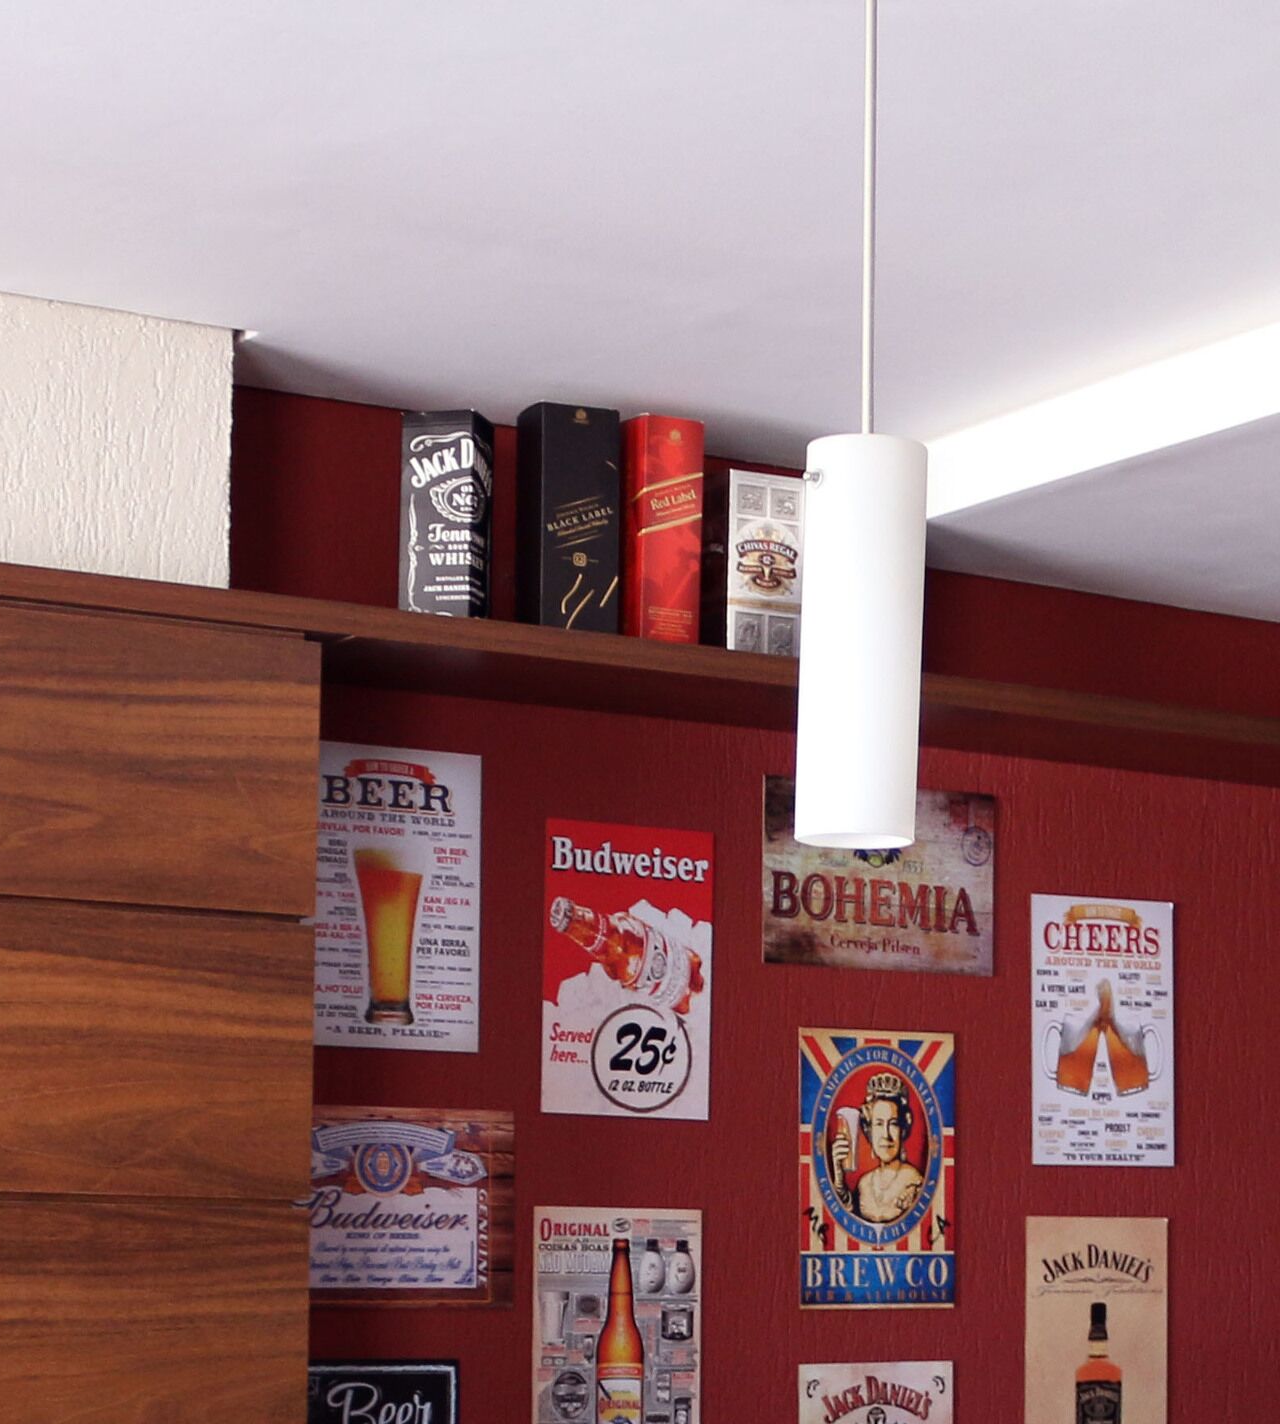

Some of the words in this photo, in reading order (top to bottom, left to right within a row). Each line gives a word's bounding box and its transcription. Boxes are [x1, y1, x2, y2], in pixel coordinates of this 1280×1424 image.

[409, 446, 459, 488] JACK
[650, 497, 670, 511] Red
[671, 489, 697, 504] Label
[546, 515, 577, 532] BLACK
[582, 506, 614, 522] LABEL
[739, 542, 768, 553] CHIVAS
[321, 774, 454, 815] BEER
[318, 822, 350, 833] ERVEJA,
[353, 824, 371, 834] POR
[320, 809, 376, 821] AROUND
[381, 813, 406, 824] THE
[411, 816, 456, 828] WORLD
[551, 836, 709, 882] Budweiser
[770, 870, 980, 937] BOHEMIA
[416, 946, 432, 955] PER
[419, 938, 438, 946] UNA
[830, 933, 878, 954] Cerveja
[882, 936, 920, 955] Pilsen
[1043, 921, 1160, 956] CHEERS
[1045, 956, 1092, 967] AROUND
[1095, 958, 1118, 969] THE
[1123, 960, 1162, 970] WORLD
[550, 1022, 594, 1045] Served
[550, 1044, 589, 1064] here...
[609, 1022, 677, 1077] 25¢
[608, 1079, 620, 1092] 12
[622, 1080, 636, 1093] OZ.
[638, 1081, 674, 1095] BOTTLE
[819, 1052, 864, 1112] CAMPAIGN
[865, 1050, 889, 1062] FOR
[891, 1053, 917, 1078] REAL
[308, 1189, 470, 1231] Budweiser
[477, 1188, 489, 1288] GENUINE
[540, 1218, 610, 1242] ORIGINAL
[883, 1222, 908, 1240] THE
[805, 1256, 949, 1288] BREWCO
[1041, 1250, 1084, 1284] JACK
[1087, 1243, 1154, 1284] DANIEL'S
[822, 1384, 863, 1424] JACK
[865, 1375, 933, 1421] DANIEL'S
